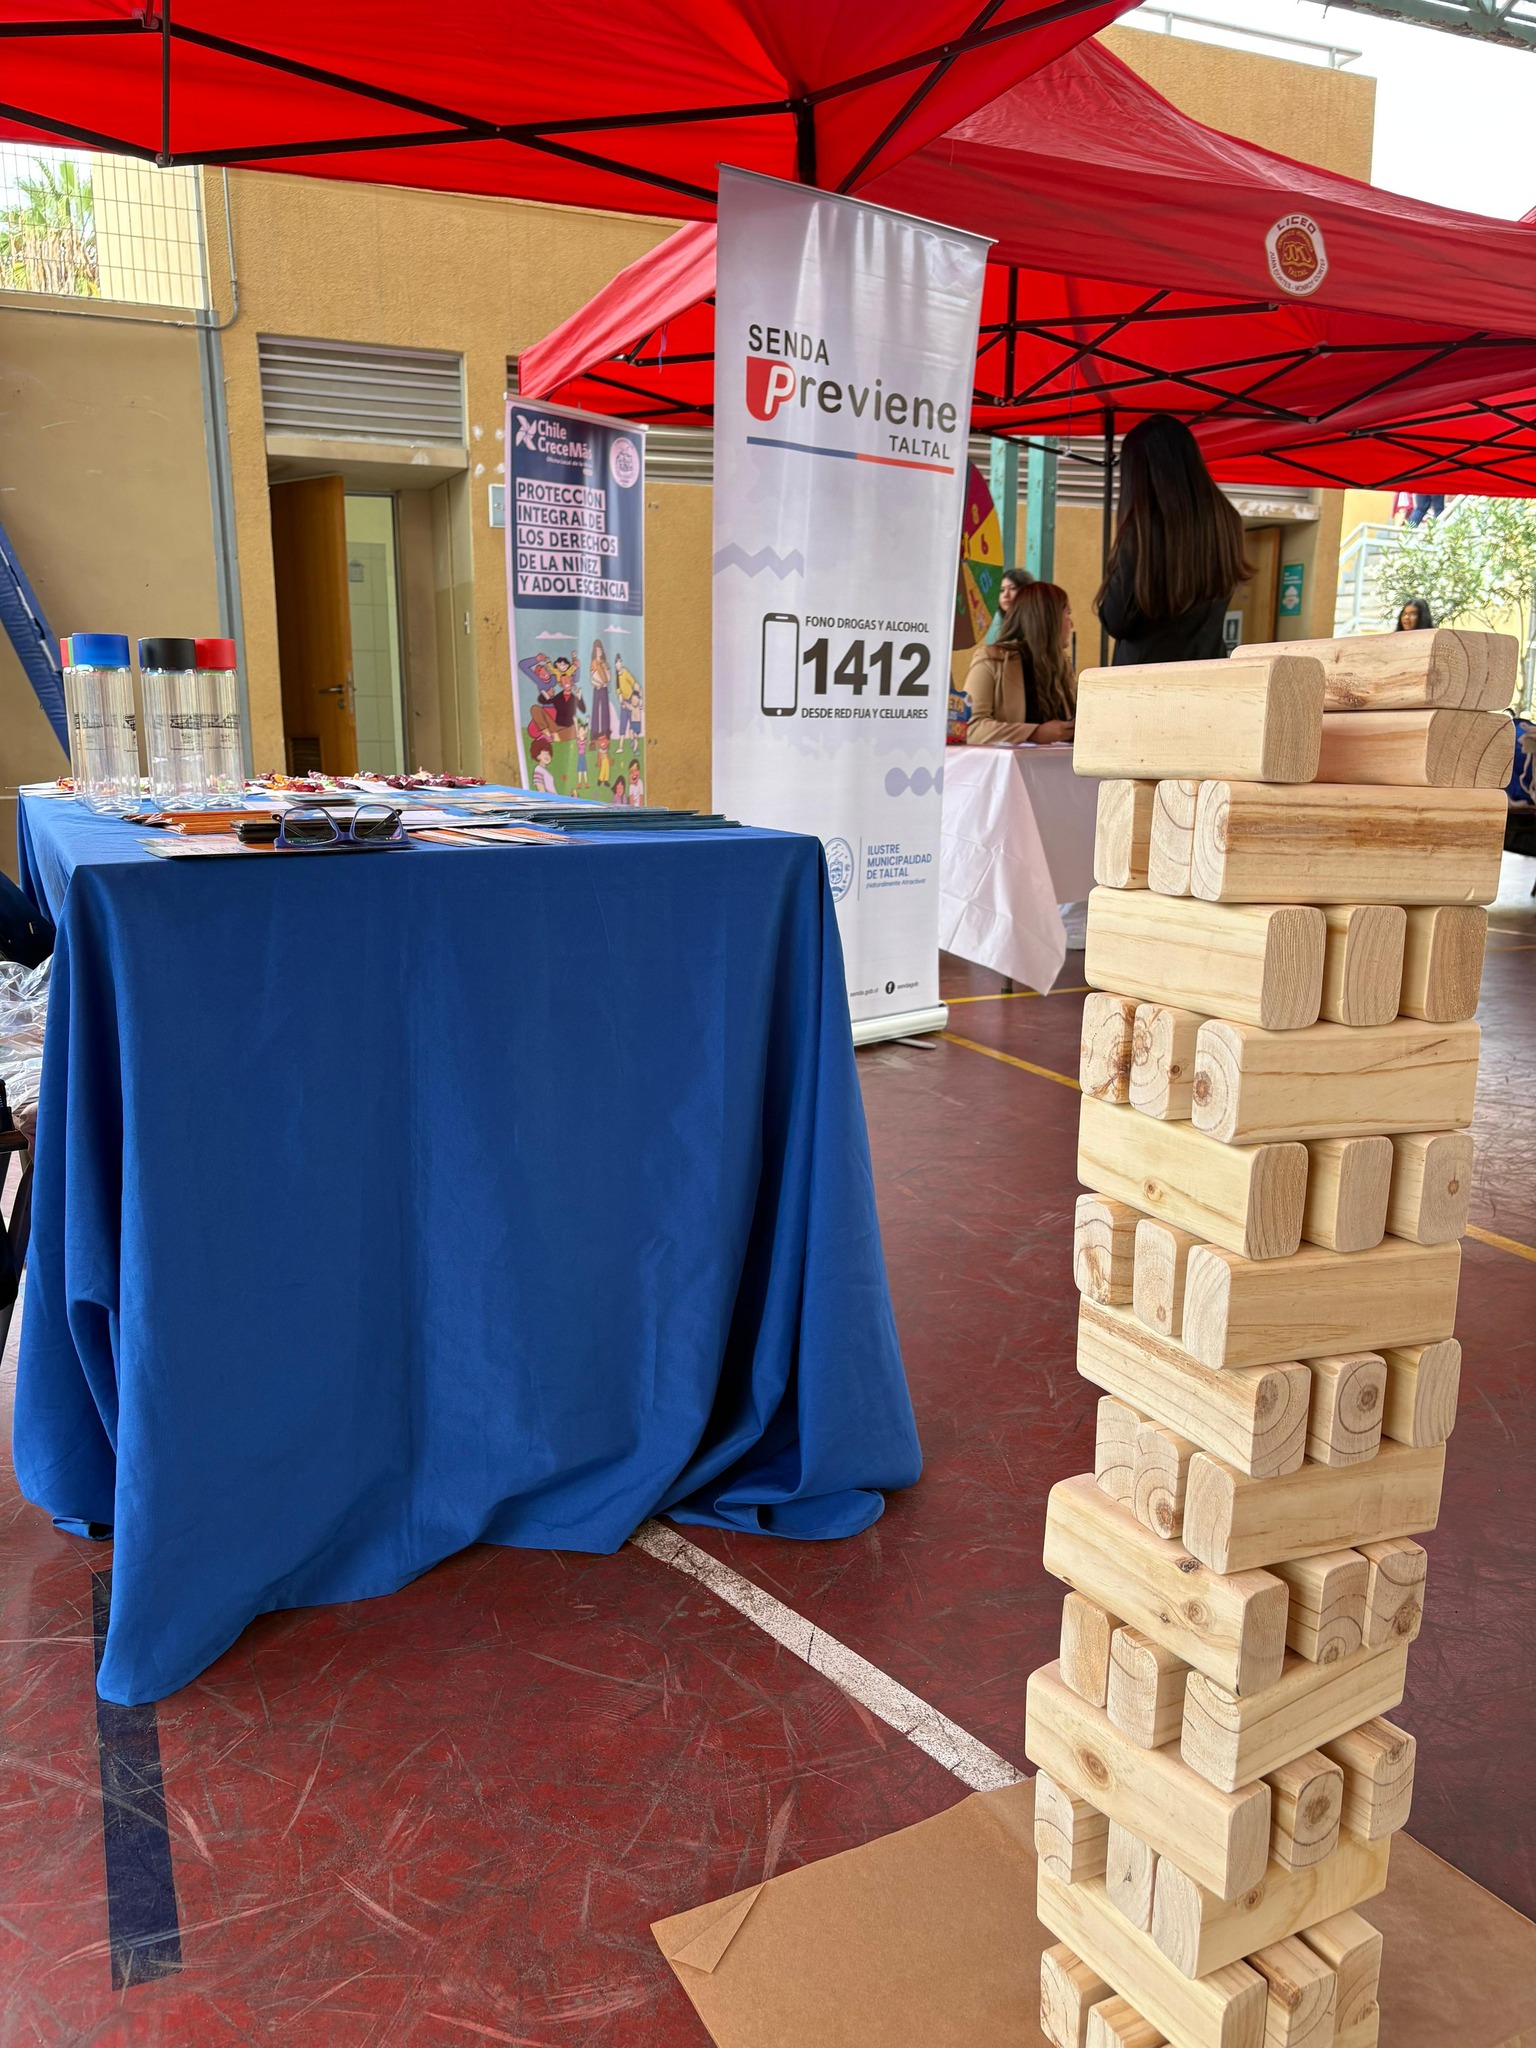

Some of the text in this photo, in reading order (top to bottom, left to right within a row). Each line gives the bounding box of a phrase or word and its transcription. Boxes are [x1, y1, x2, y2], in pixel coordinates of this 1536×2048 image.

[1277, 216, 1316, 235] LICEO
[748, 324, 830, 366] SENDA
[764, 364, 957, 433] Previene
[537, 419, 567, 440] Chile
[889, 435, 951, 460] TALTAL
[518, 481, 602, 509] PROTECCIÓN
[518, 505, 603, 530] INTEGRAL DE
[518, 528, 616, 554] LOS DERECHOS
[519, 552, 598, 575] DE LA NIÑEZ
[520, 575, 627, 599] Y ADOLESCENCIA
[805, 616, 930, 633] FONO DROGAS Y ALCOHOL
[802, 638, 931, 697] 1412
[801, 708, 929, 719] DESDE RED FIJA Y CELULARES
[867, 844, 900, 856] ILUSTRE
[867, 853, 932, 868] MUNICIPALIDAD
[867, 867, 909, 880] DE TALTAL
